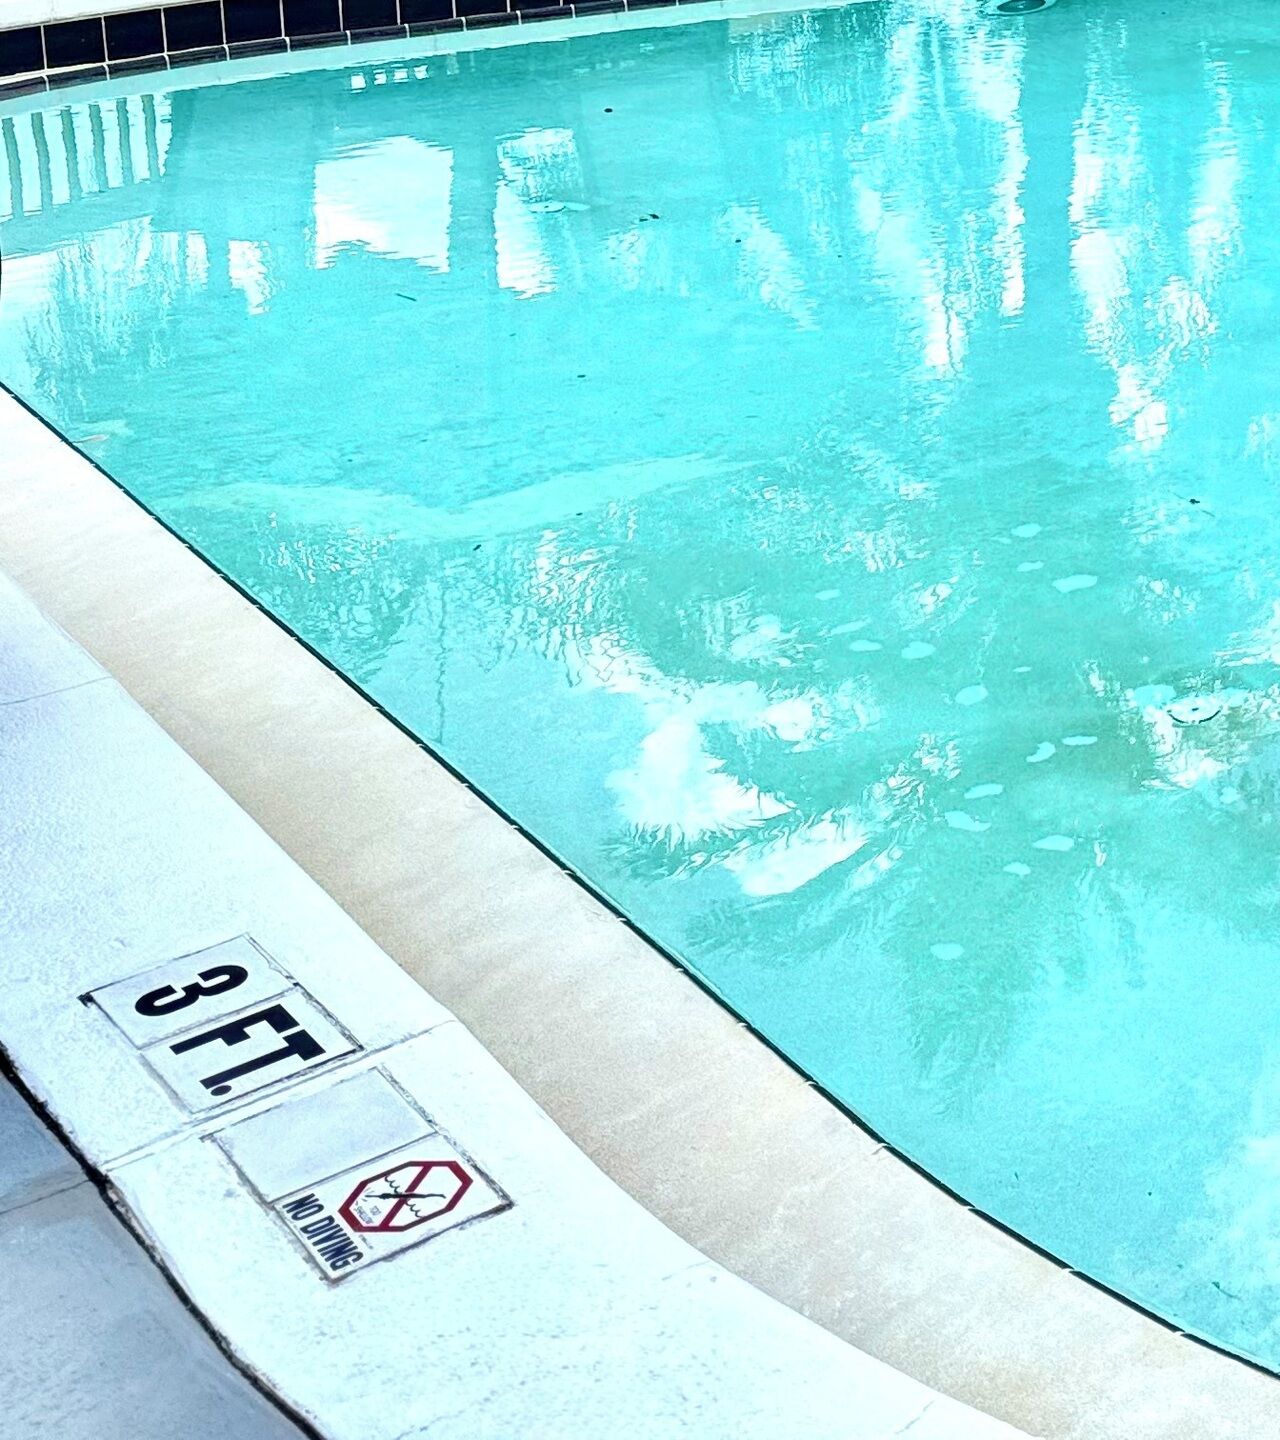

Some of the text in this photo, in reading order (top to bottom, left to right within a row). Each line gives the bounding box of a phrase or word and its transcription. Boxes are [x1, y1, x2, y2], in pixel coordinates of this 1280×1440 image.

[134, 964, 327, 1097] 3 FT.
[282, 1192, 364, 1272] NO DIVING
